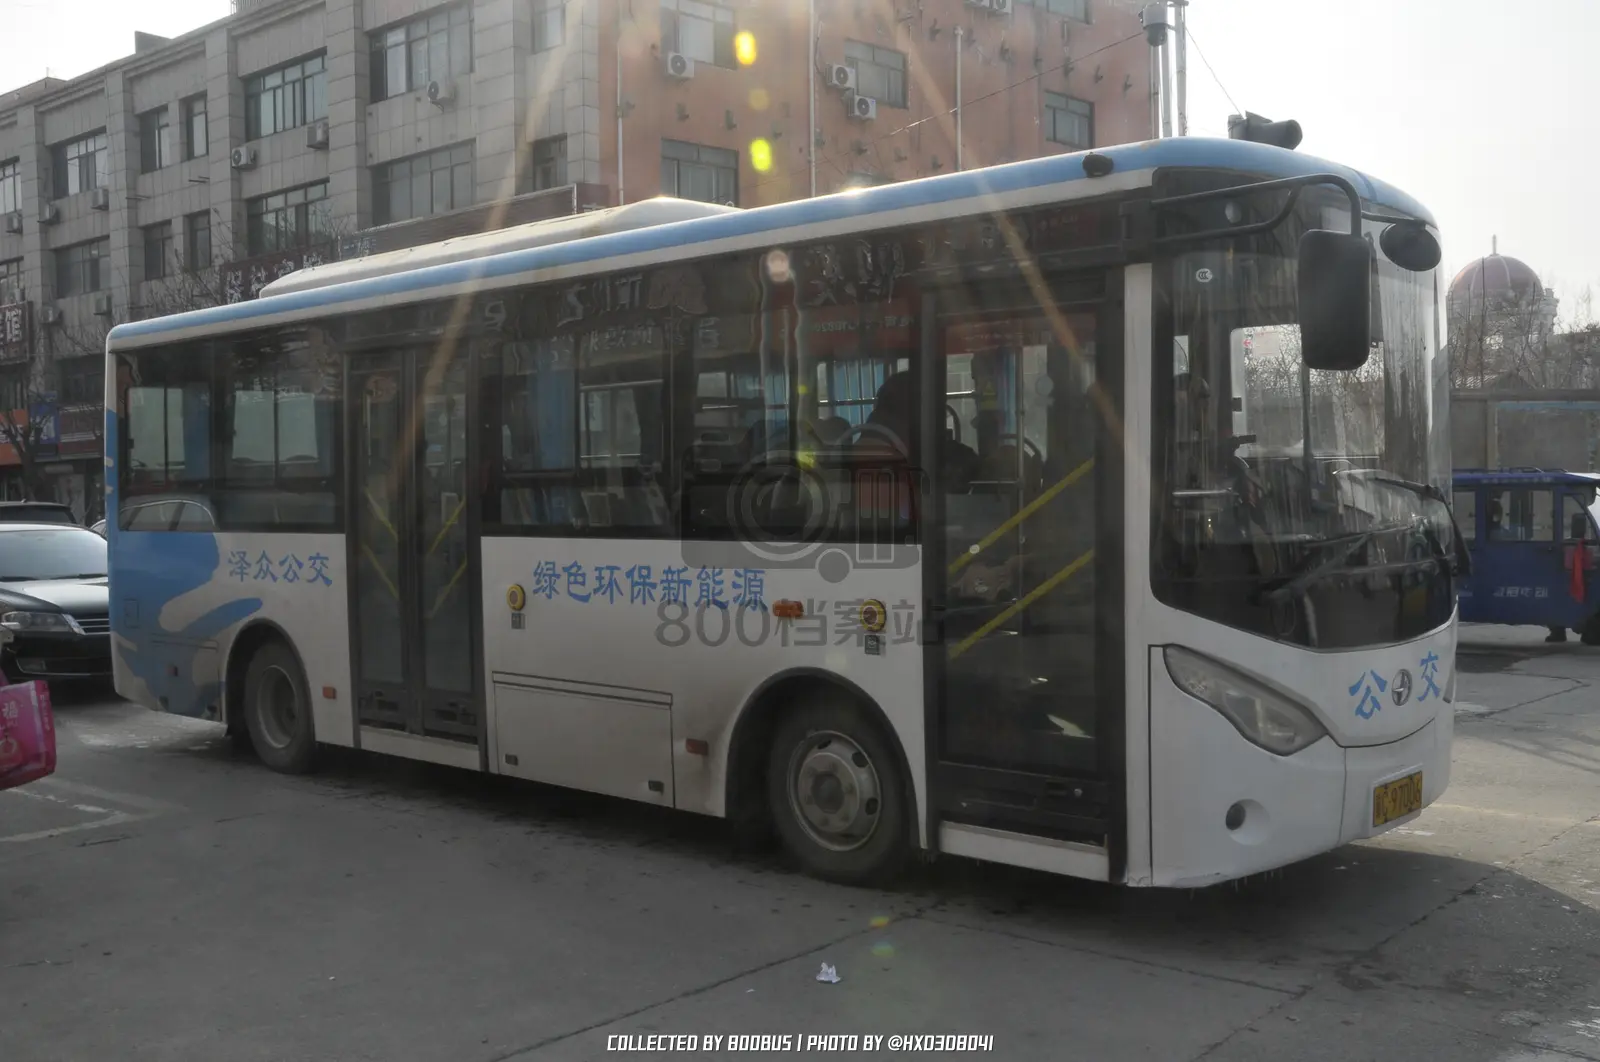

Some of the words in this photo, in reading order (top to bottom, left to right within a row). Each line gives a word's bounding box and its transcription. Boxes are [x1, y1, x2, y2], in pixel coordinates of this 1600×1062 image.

[228, 550, 333, 587] 泽众公交
[532, 560, 768, 612] 绿色环保新能源
